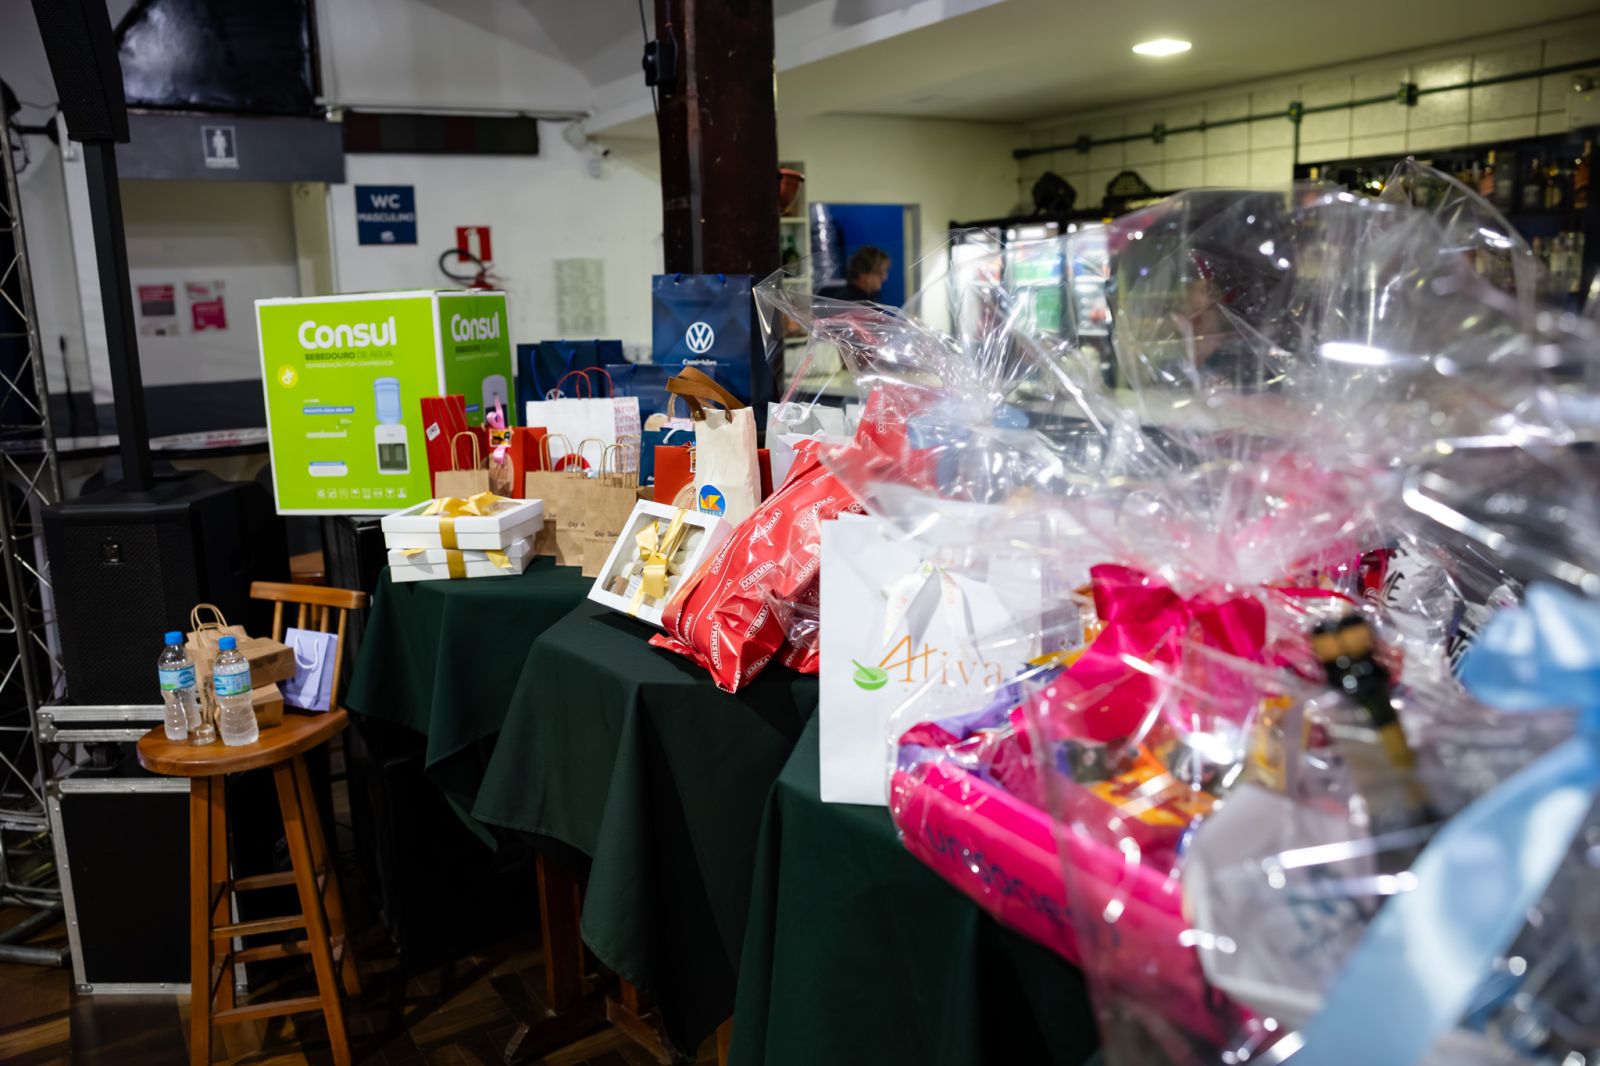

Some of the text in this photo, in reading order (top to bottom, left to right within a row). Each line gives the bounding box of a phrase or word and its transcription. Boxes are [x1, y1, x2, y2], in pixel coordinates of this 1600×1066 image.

[370, 194, 401, 209] WC
[298, 315, 397, 349] Consul
[451, 311, 500, 342] Consul
[305, 351, 356, 361] BEBEDOURO
[357, 351, 368, 359] DE
[741, 561, 775, 588] COREMMA
[712, 622, 722, 669] COREMMA
[878, 634, 1004, 687] Ativa
